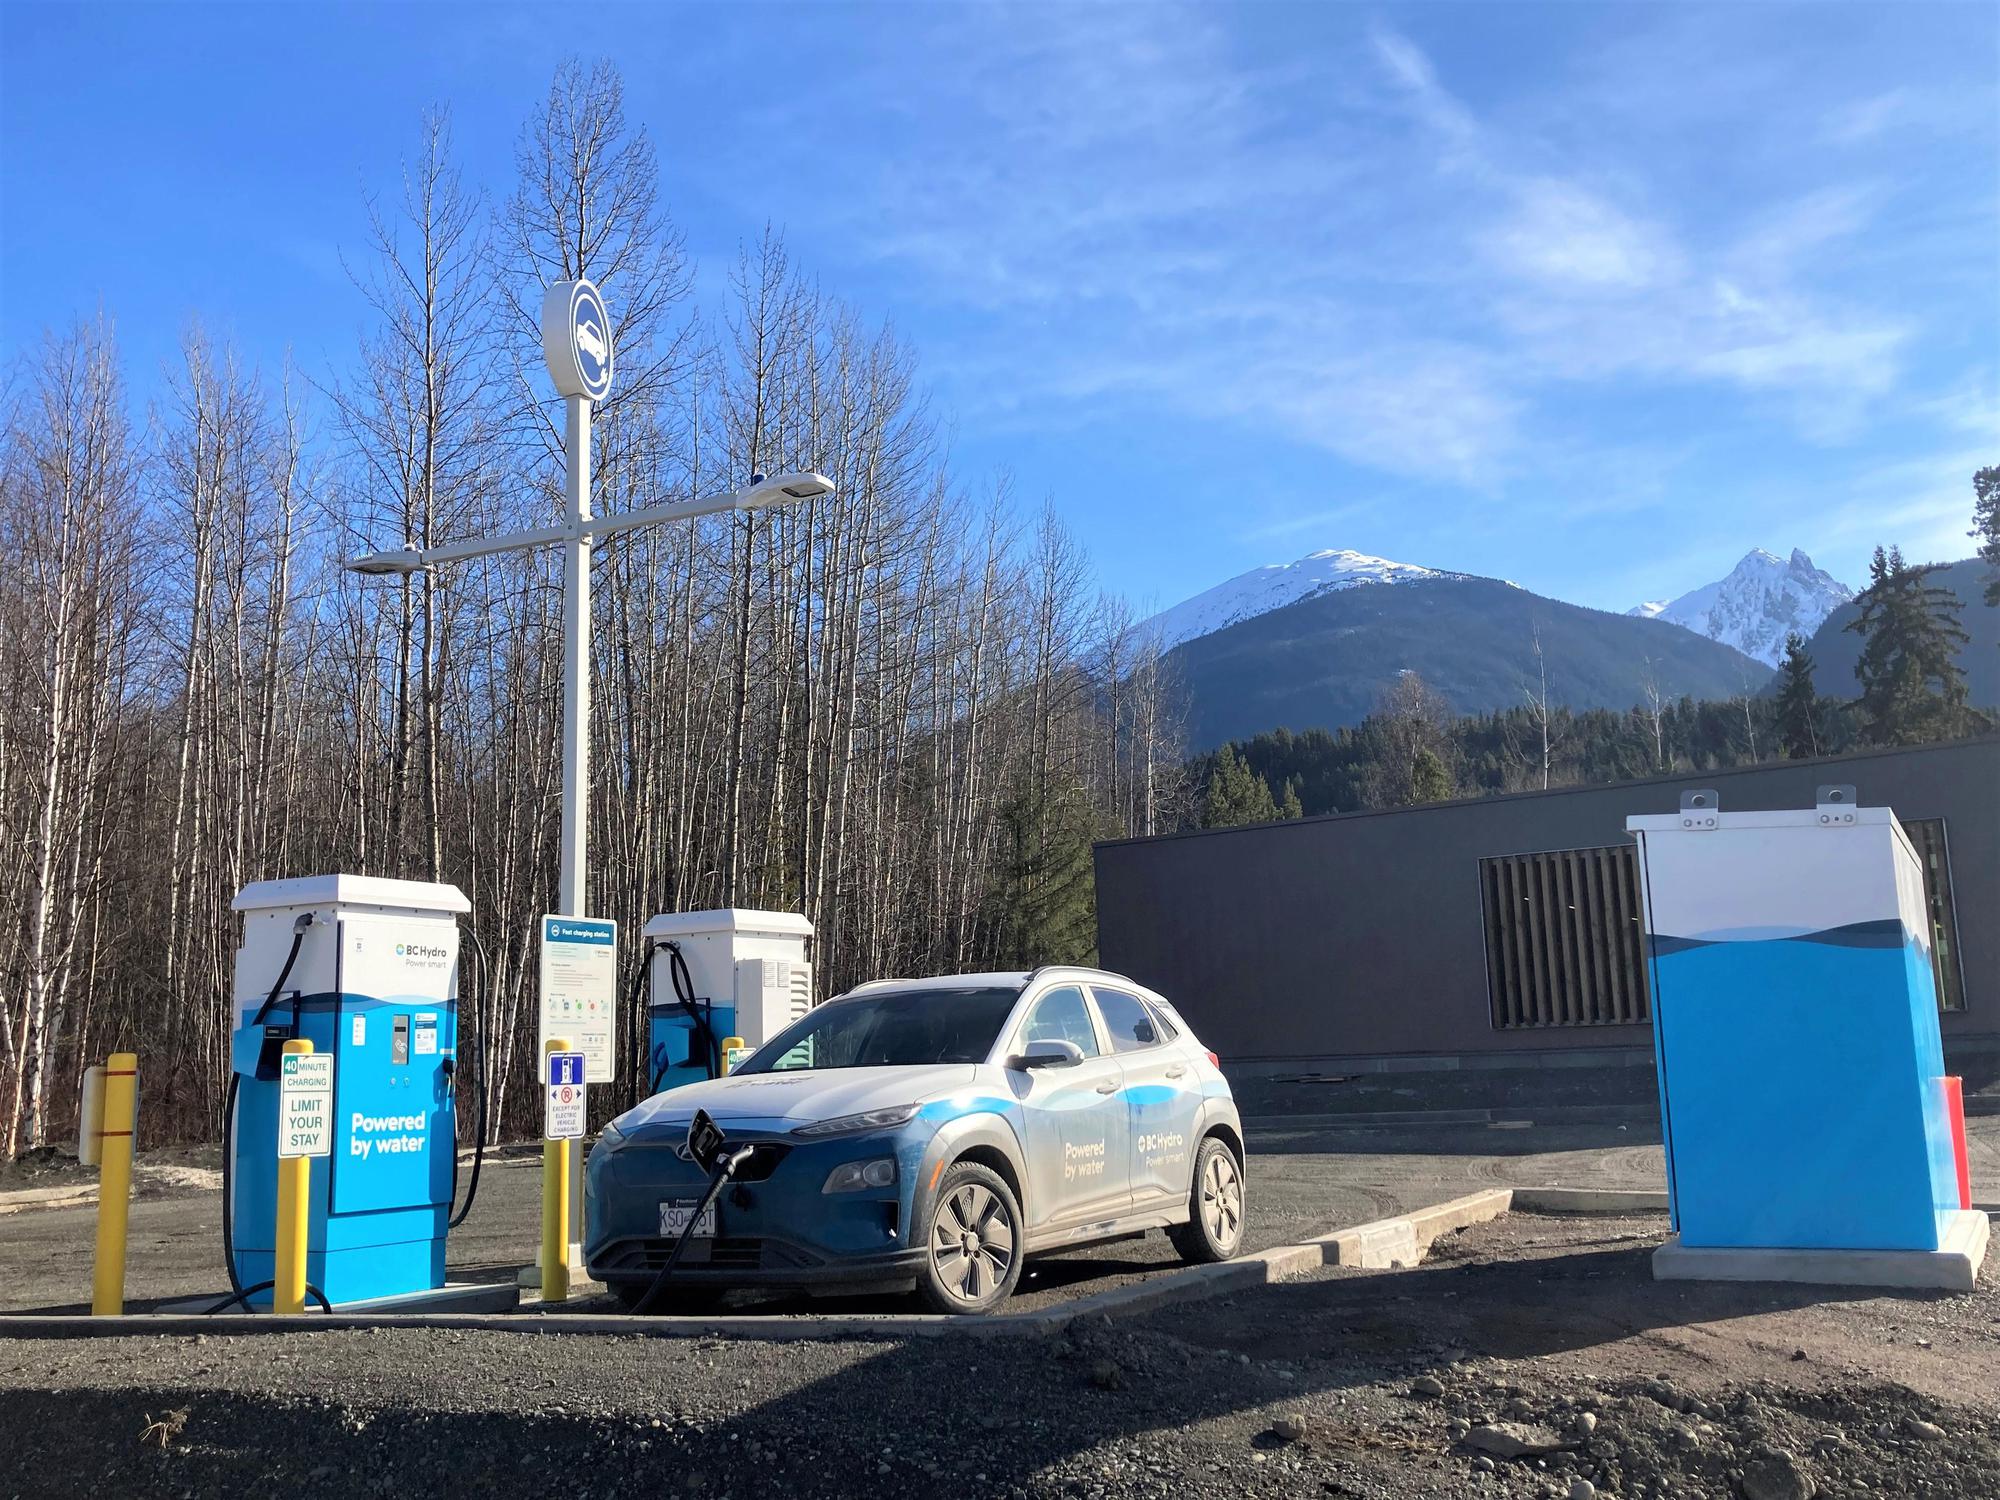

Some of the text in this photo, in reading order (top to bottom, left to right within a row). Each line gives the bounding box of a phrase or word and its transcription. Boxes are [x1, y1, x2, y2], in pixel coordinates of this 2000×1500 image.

[562, 928, 573, 936] Fast
[573, 929, 594, 938] charging
[406, 945, 447, 958] BC Hydro
[406, 959, 447, 969] Power smart
[284, 1060, 327, 1072] 40 MINUTE
[287, 1078, 327, 1087] CHARGING
[291, 1099, 322, 1112] LIMIT
[289, 1116, 322, 1129] YOUR
[351, 1110, 426, 1133] Powered
[290, 1133, 320, 1147] STAY
[1146, 1131, 1183, 1153] BC Hydro
[351, 1134, 426, 1160] by water
[1065, 1138, 1105, 1159] Powered
[1145, 1152, 1184, 1168] Power smart
[1065, 1160, 1105, 1182] by water
